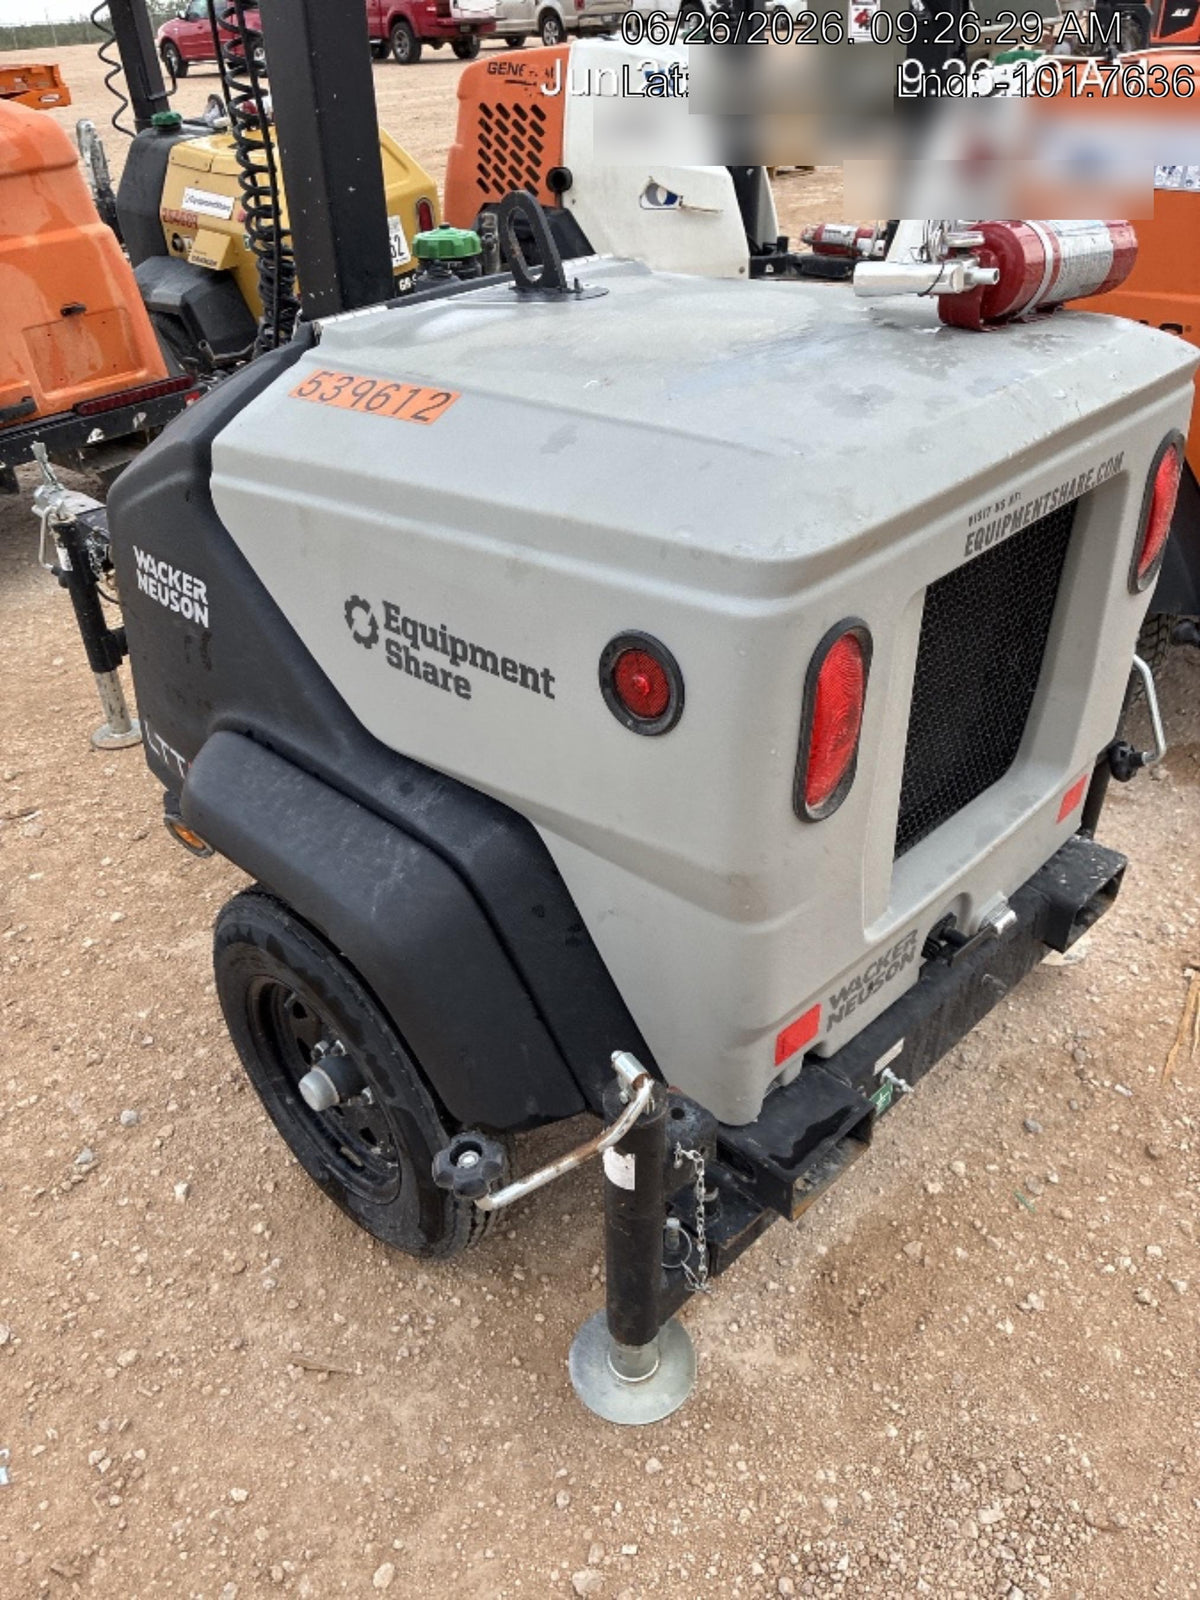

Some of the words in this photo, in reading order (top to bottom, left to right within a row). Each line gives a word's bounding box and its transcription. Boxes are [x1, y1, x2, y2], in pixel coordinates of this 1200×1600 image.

[297, 371, 452, 422] 539612
[963, 450, 1125, 557] EQUIPMENTSHARE.COM
[968, 506, 992, 527] VISIT
[132, 544, 209, 605] WACKER
[136, 568, 209, 629] NEUSON
[382, 599, 556, 700] Equipment
[384, 637, 472, 701] Share
[826, 945, 917, 1033] NEUSON
[829, 929, 918, 1010] WACKER
